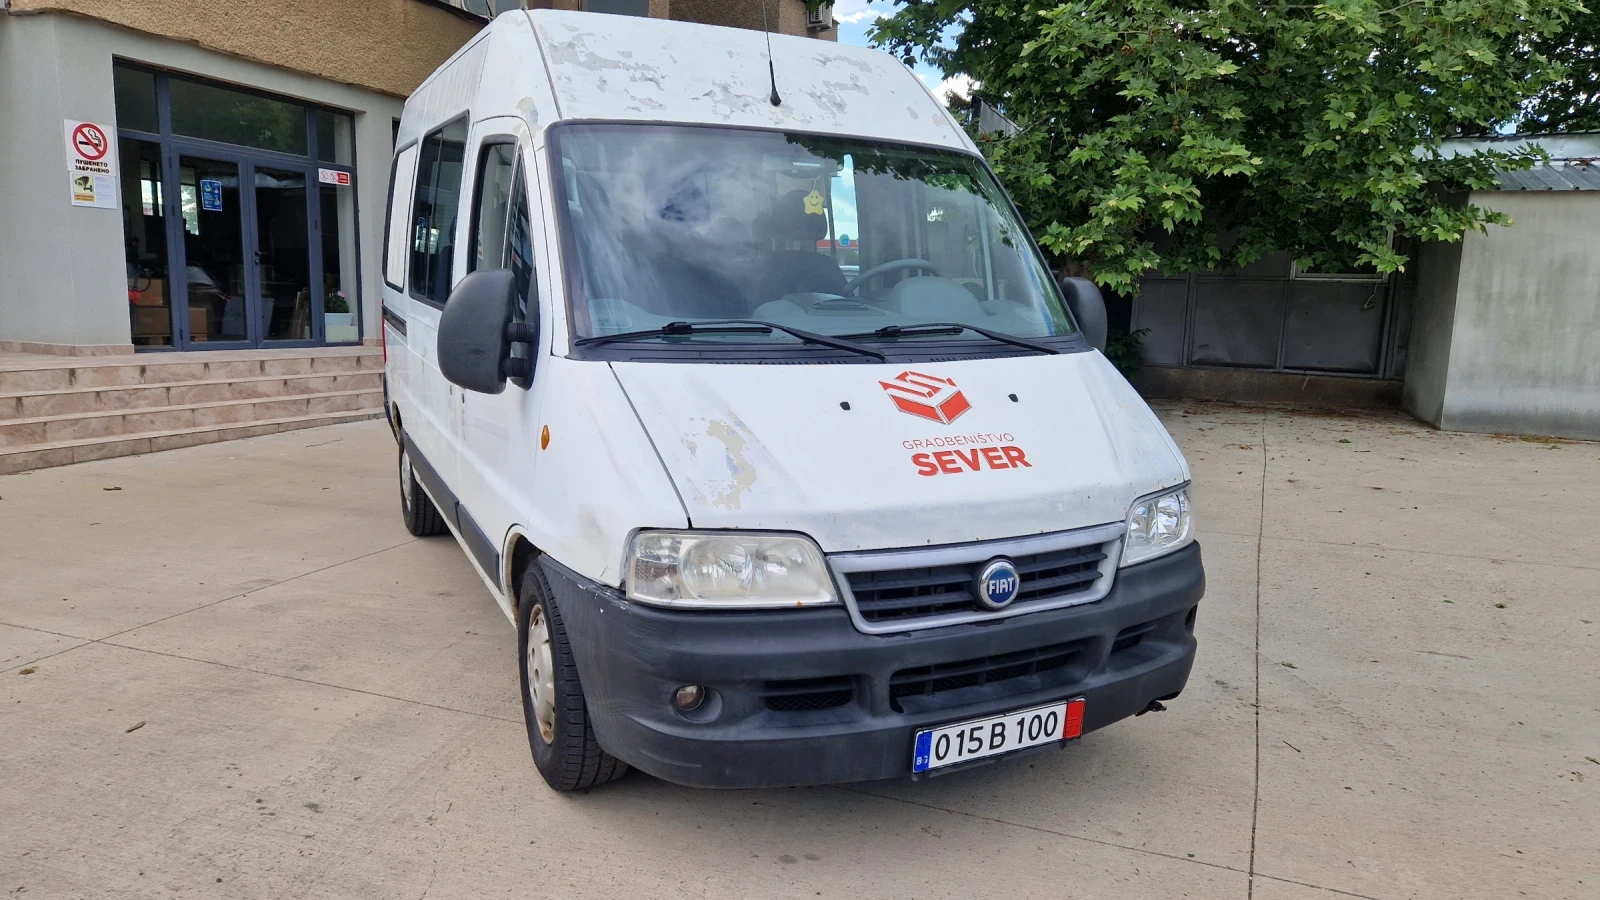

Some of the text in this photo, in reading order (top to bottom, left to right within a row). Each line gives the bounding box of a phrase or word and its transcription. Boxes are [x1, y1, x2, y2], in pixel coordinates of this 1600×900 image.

[75, 159, 108, 167] ПУШЕНЕТО
[75, 165, 110, 173] ЗАБРАНЕНО
[902, 432, 1015, 450] GRADBENIŠTVO
[911, 445, 1033, 477] SEVER
[988, 577, 1015, 595] FIAT
